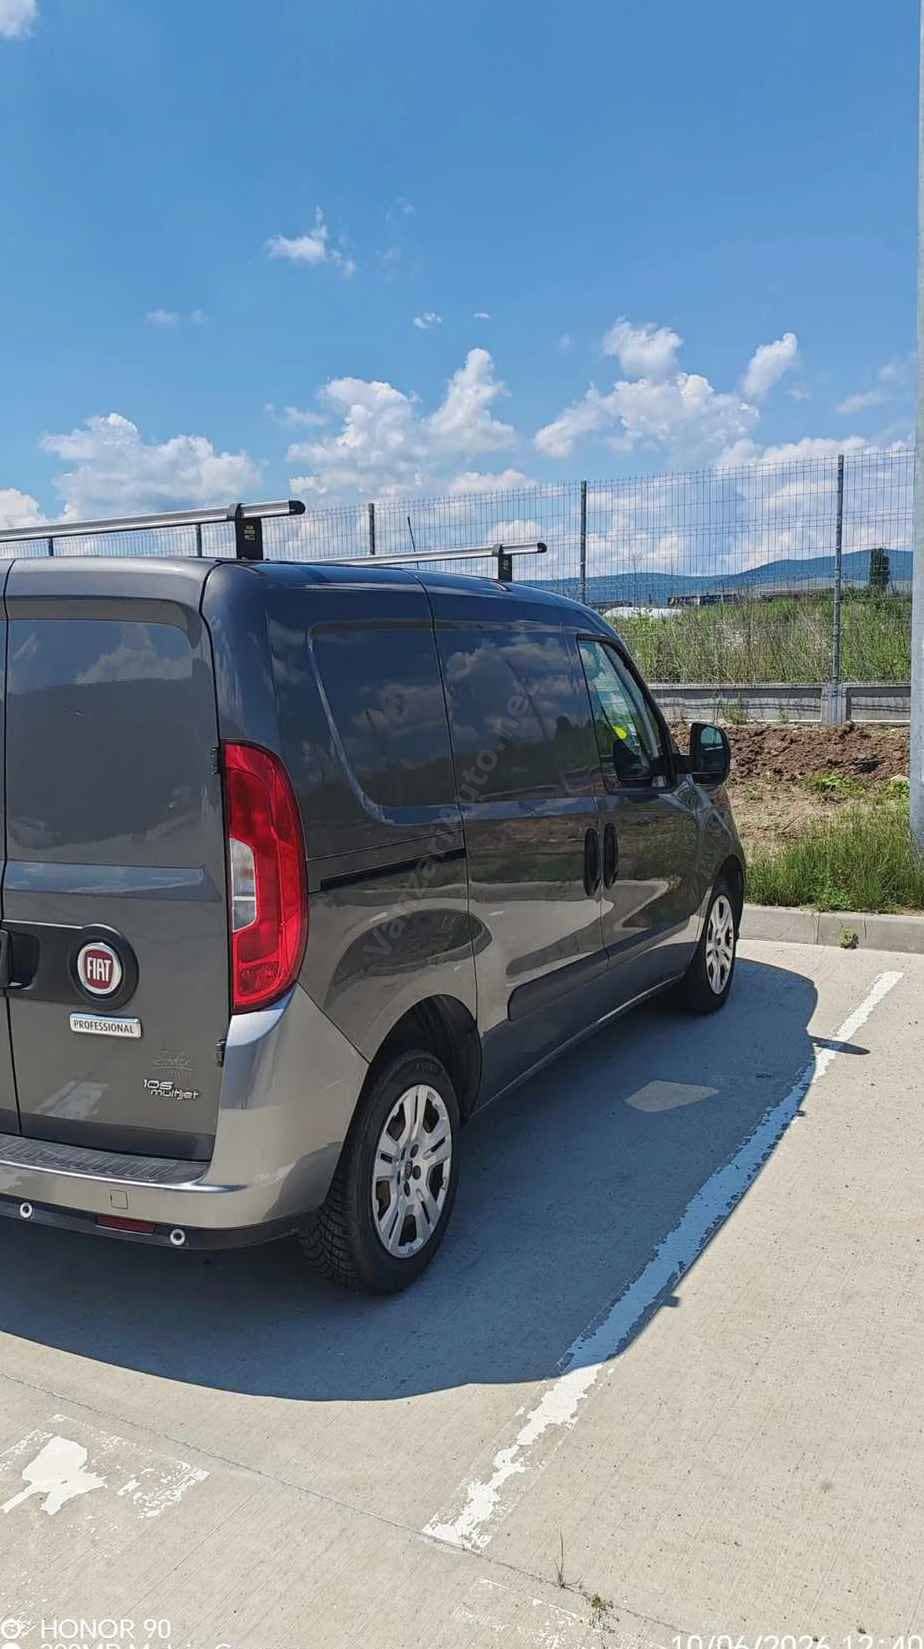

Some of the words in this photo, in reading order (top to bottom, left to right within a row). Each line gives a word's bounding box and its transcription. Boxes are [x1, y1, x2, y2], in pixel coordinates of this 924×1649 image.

[87, 957, 112, 982] FIAT
[73, 1019, 135, 1034] PROFESSIONAL
[143, 1079, 174, 1090] 105
